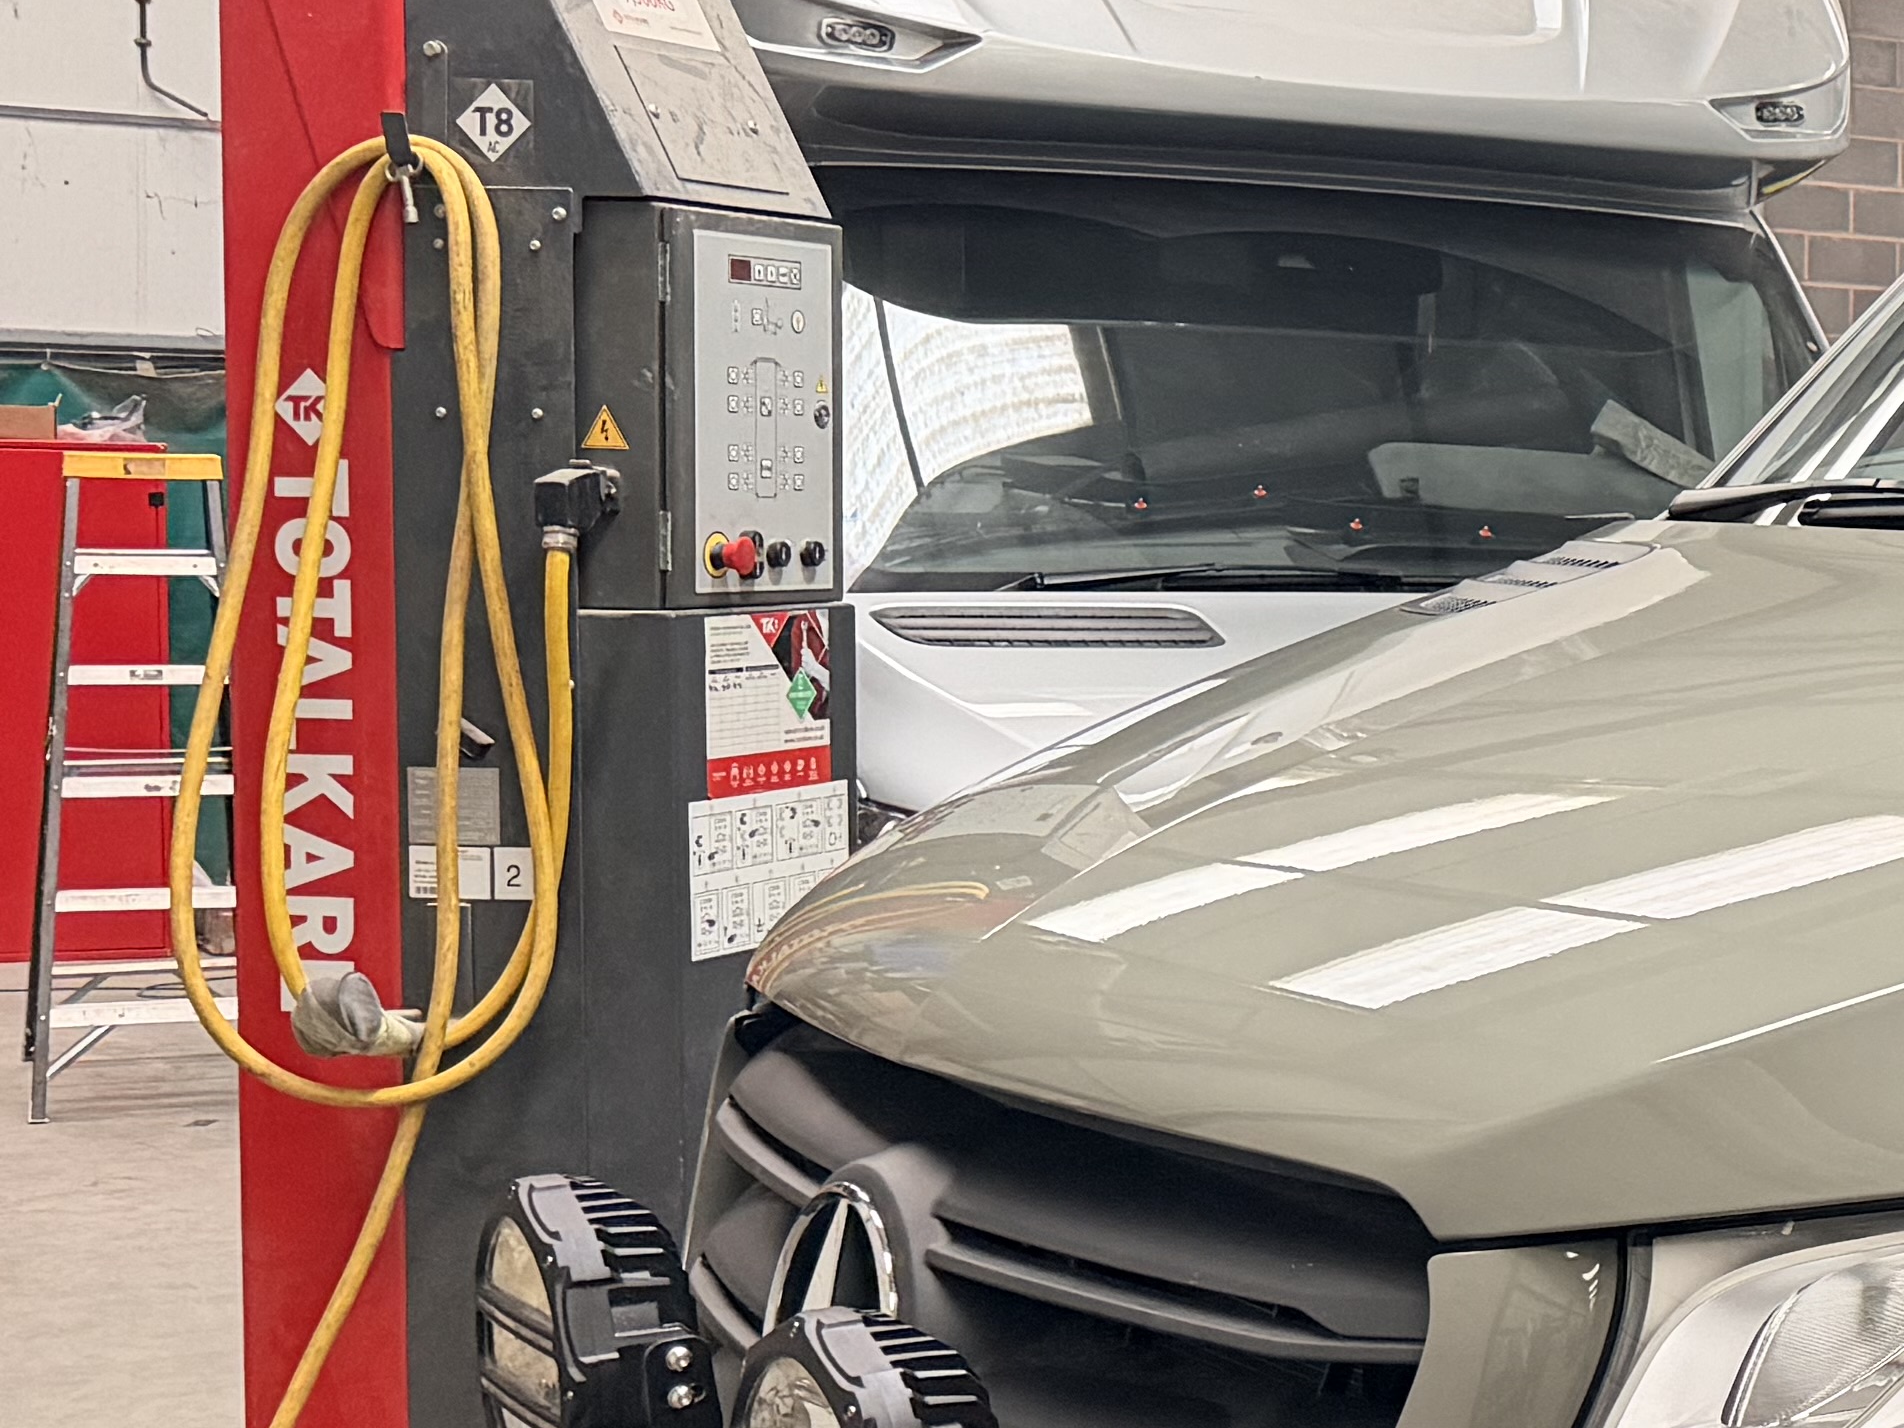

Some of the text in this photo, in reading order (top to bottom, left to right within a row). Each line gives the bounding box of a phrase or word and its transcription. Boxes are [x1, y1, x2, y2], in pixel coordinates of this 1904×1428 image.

[471, 106, 515, 138] T8
[283, 395, 325, 423] TK
[506, 864, 522, 888] 2
